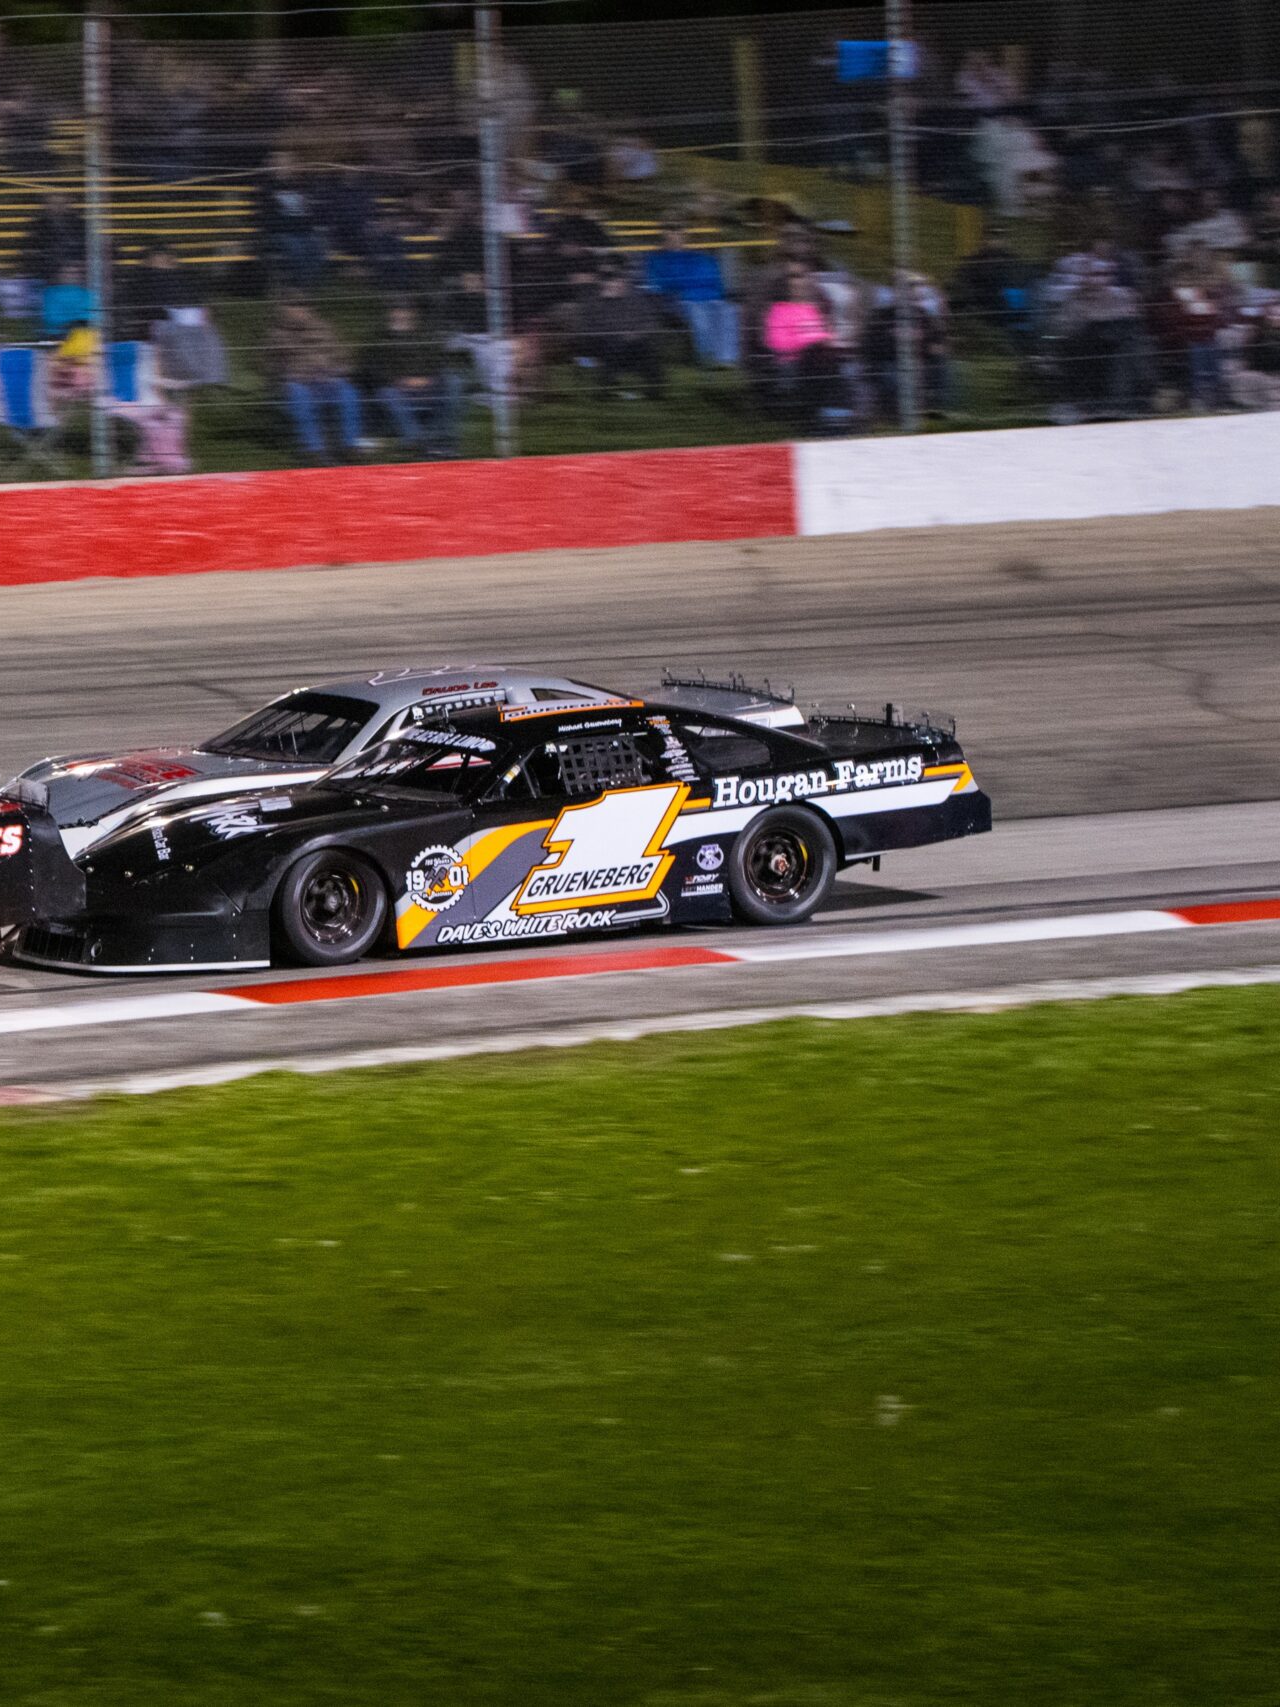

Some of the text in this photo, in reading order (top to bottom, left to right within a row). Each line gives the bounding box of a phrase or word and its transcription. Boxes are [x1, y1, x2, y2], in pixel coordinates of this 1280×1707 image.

[713, 755, 923, 808] Hougan Farms
[511, 781, 691, 916] 1
[405, 868, 426, 891] 19
[527, 862, 654, 898] GRUENEBERG
[437, 909, 616, 942] DAVE'S WHITE ROCK
